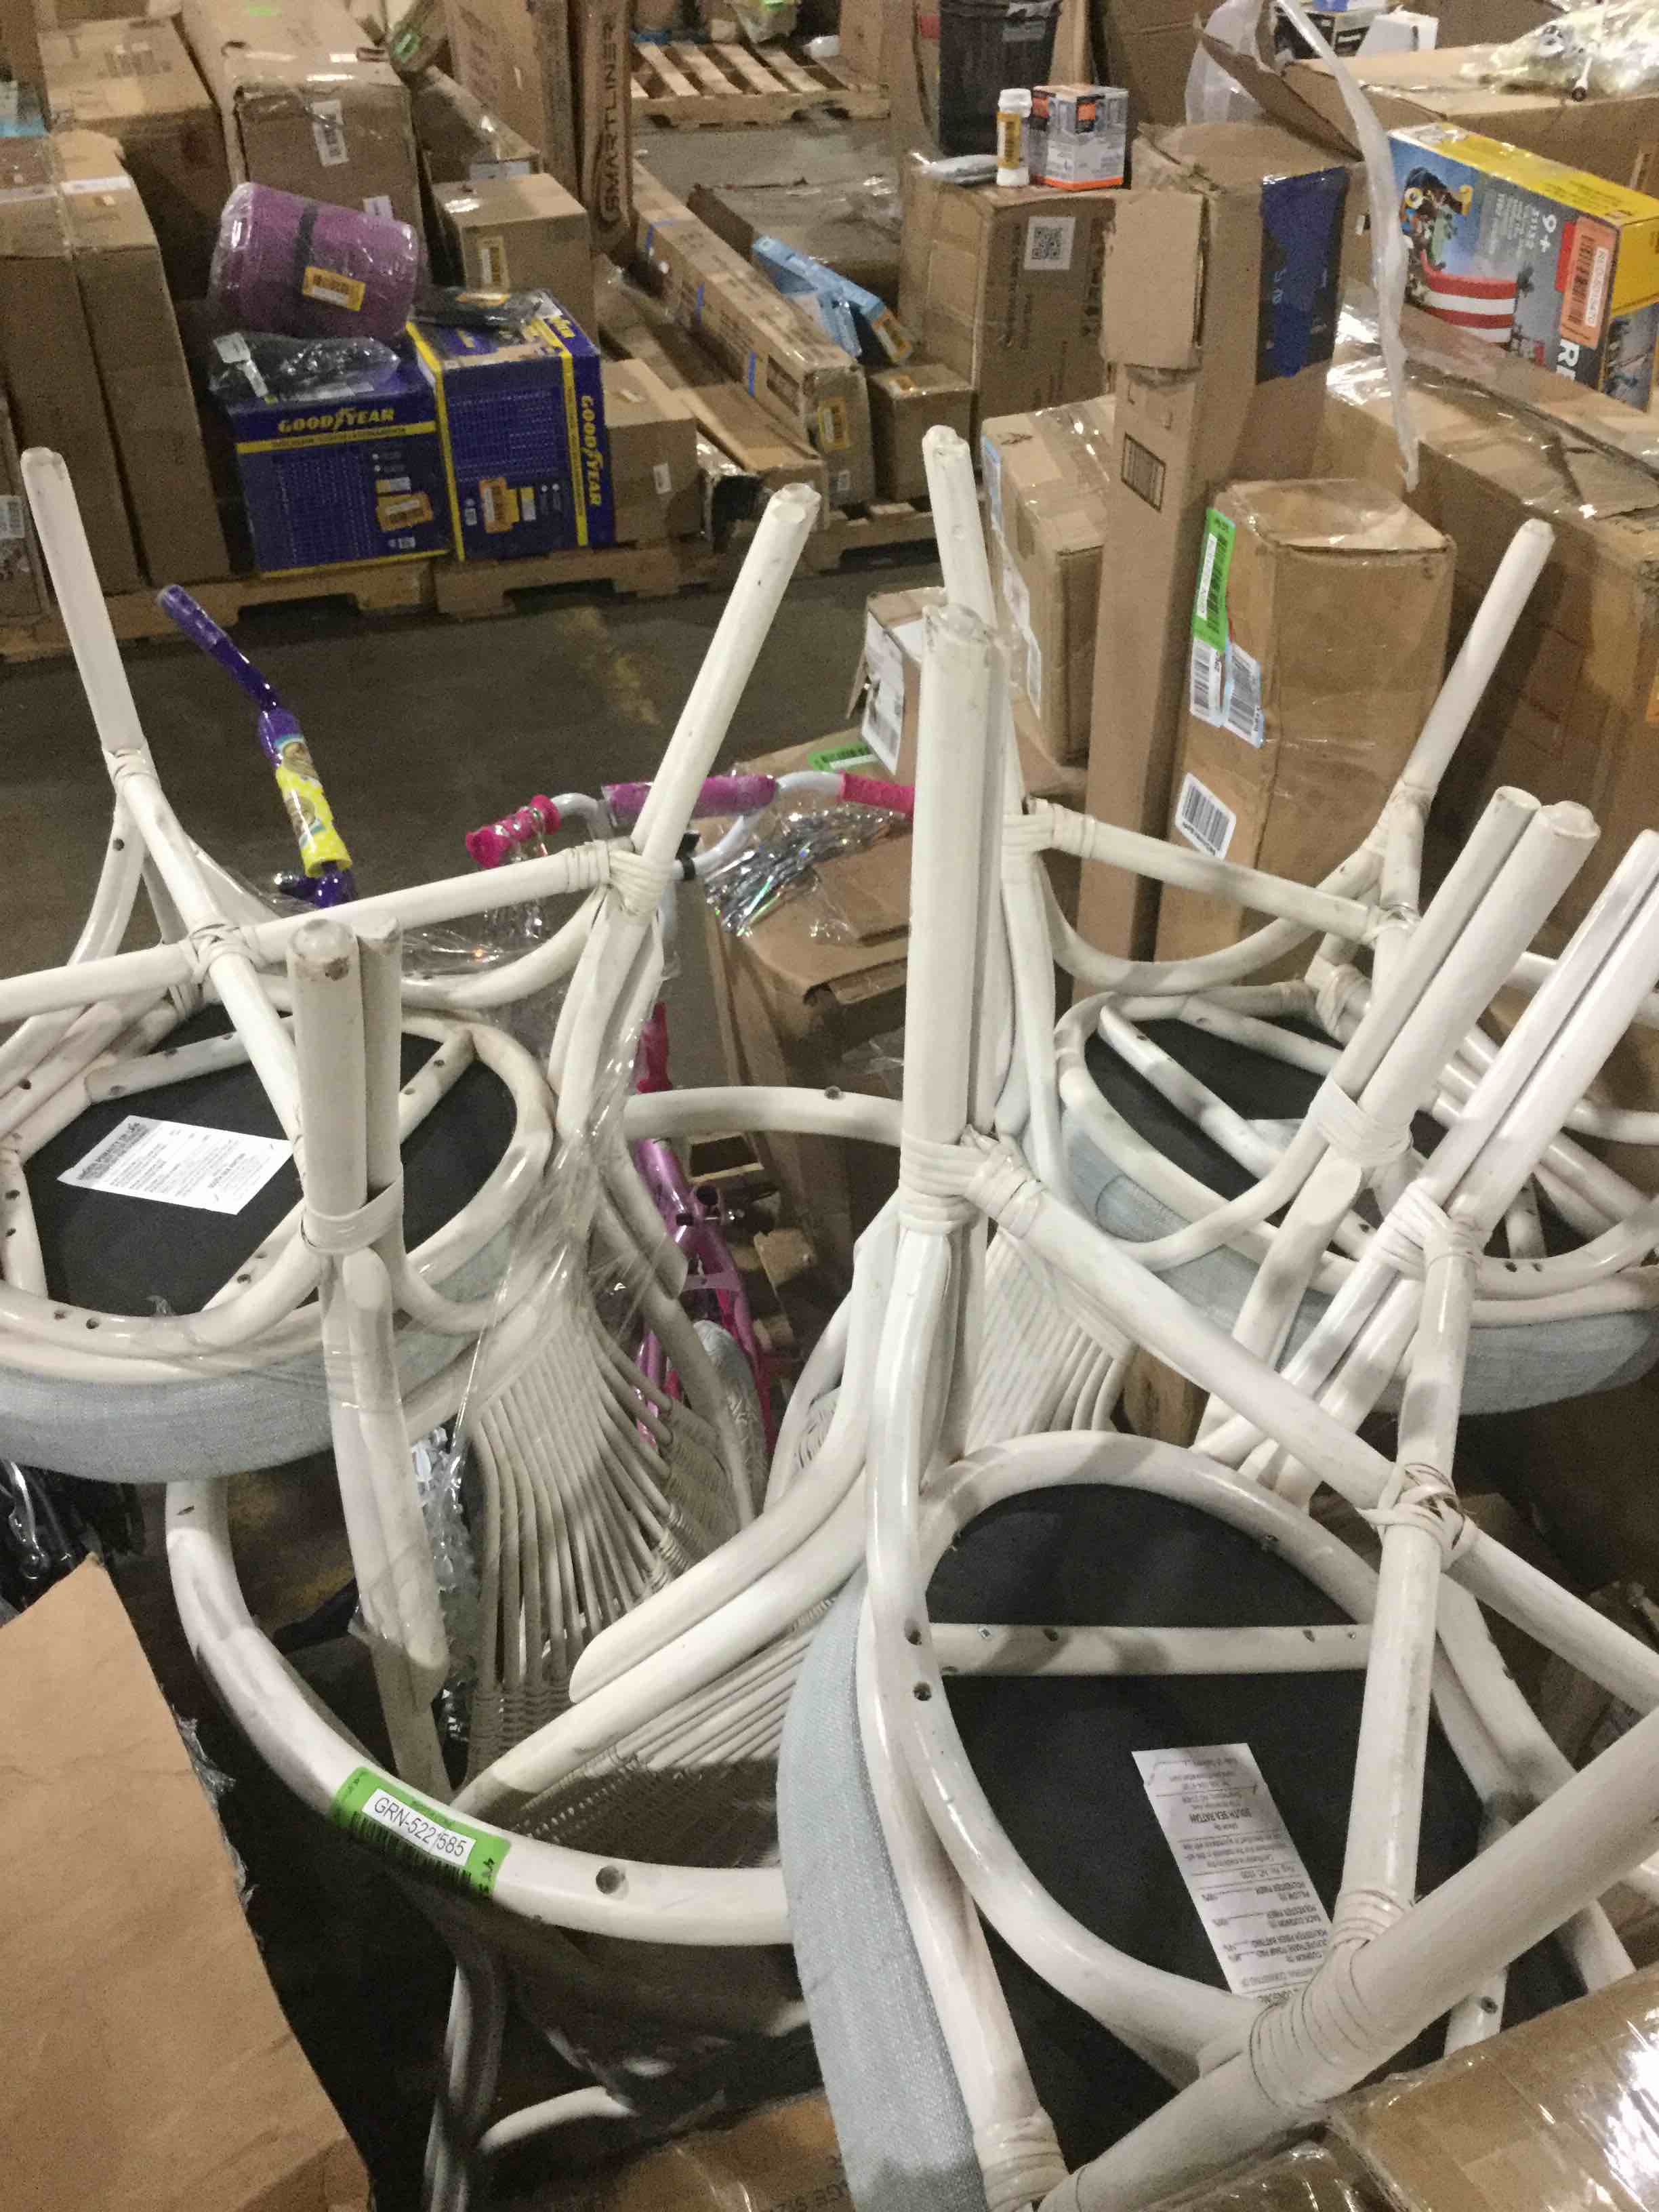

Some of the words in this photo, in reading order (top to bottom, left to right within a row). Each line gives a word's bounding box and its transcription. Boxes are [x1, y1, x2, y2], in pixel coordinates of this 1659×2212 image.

[601, 18, 619, 213] SMARTLINER
[1539, 214, 1557, 253] 9+
[277, 407, 395, 434] GOODYEAR
[580, 395, 603, 506] GOODYEAR
[374, 1797, 467, 1858] GRN-5221585
[1189, 1813, 1215, 1822] RATTAN
[1215, 1811, 1229, 1820] SEA
